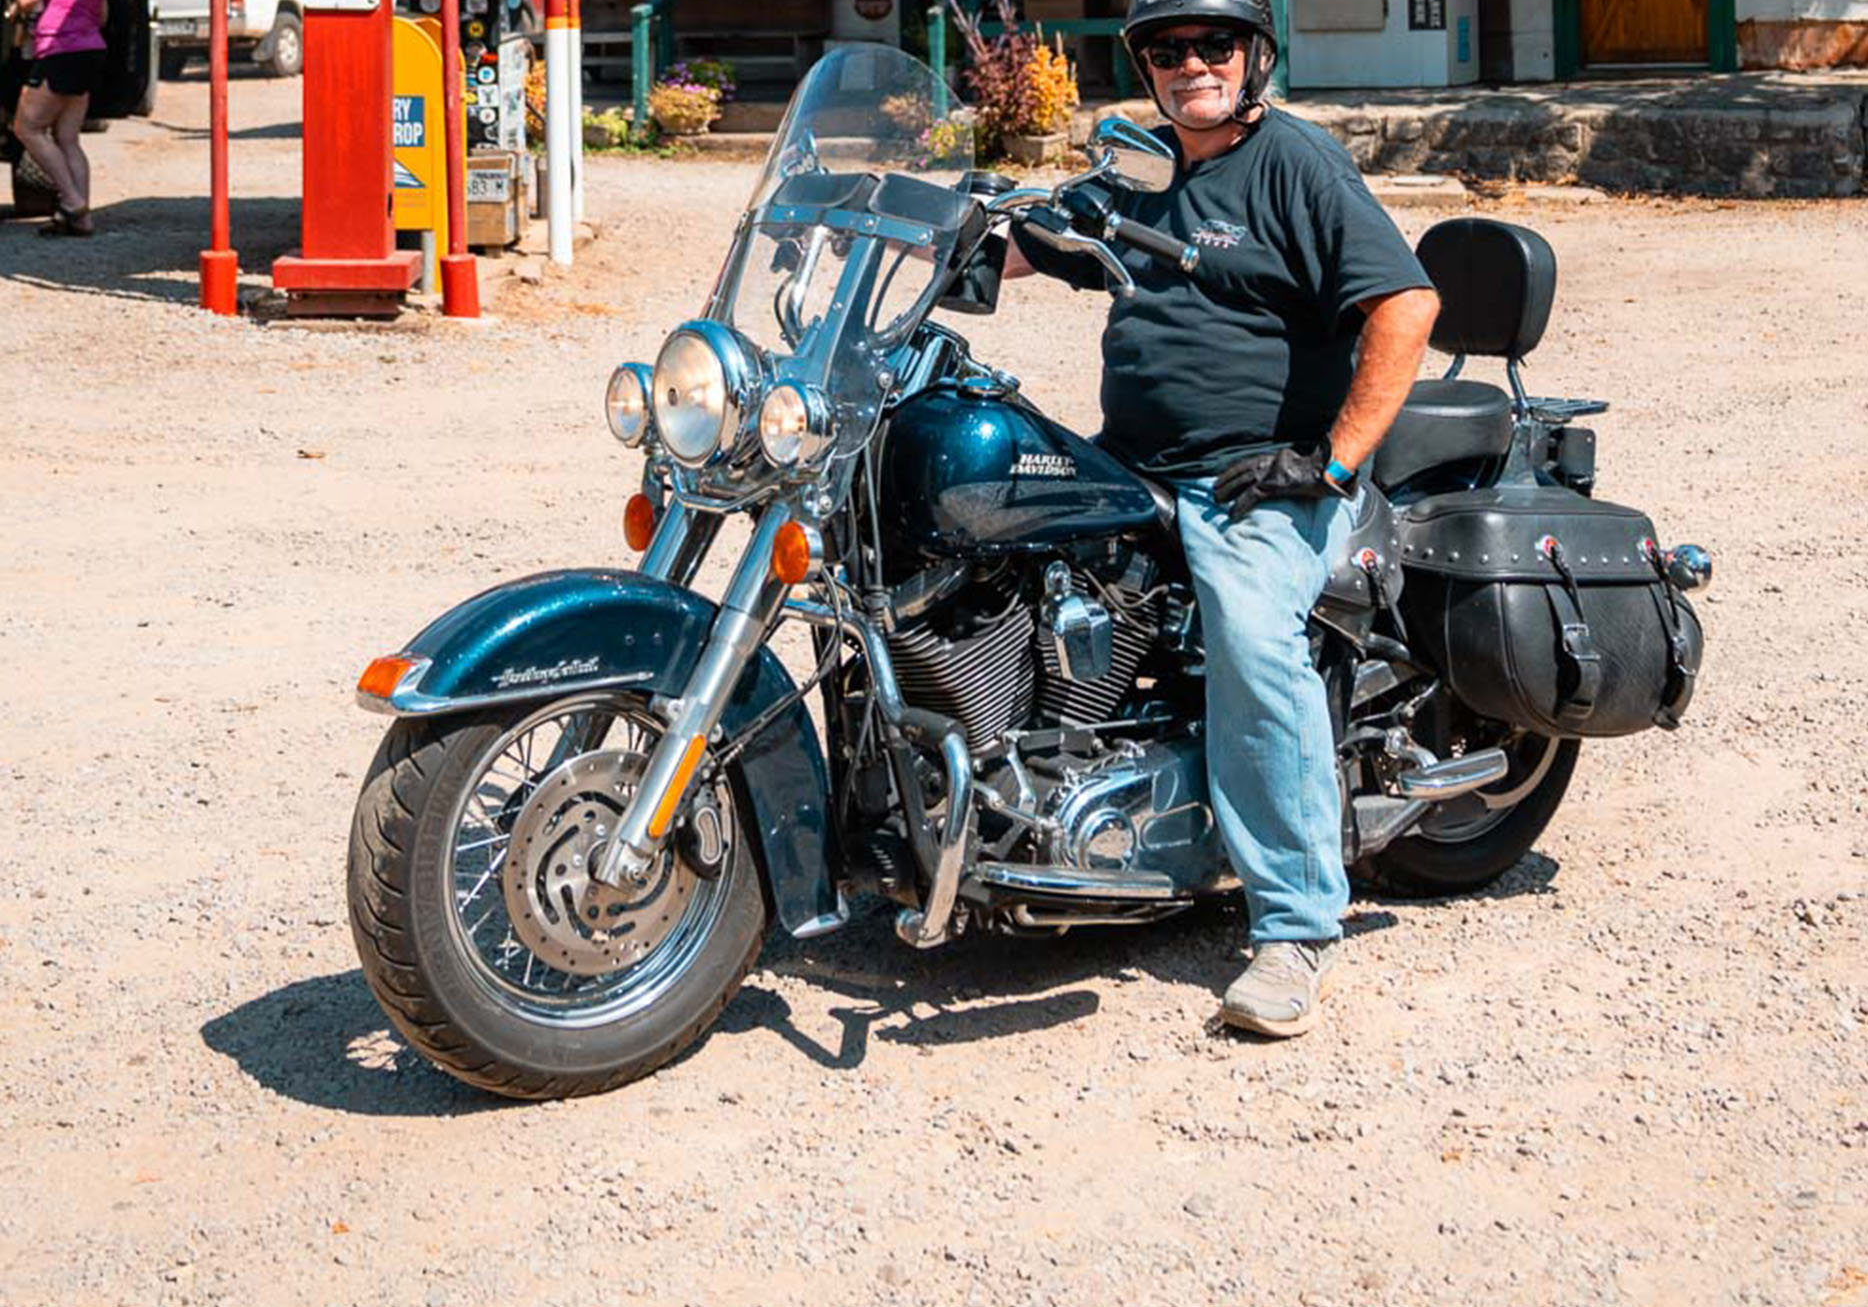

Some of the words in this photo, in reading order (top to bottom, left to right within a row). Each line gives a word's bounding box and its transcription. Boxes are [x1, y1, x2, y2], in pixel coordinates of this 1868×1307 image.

[393, 98, 412, 121] RY
[393, 121, 423, 146] ROP
[1008, 463, 1077, 477] DAVIDSON
